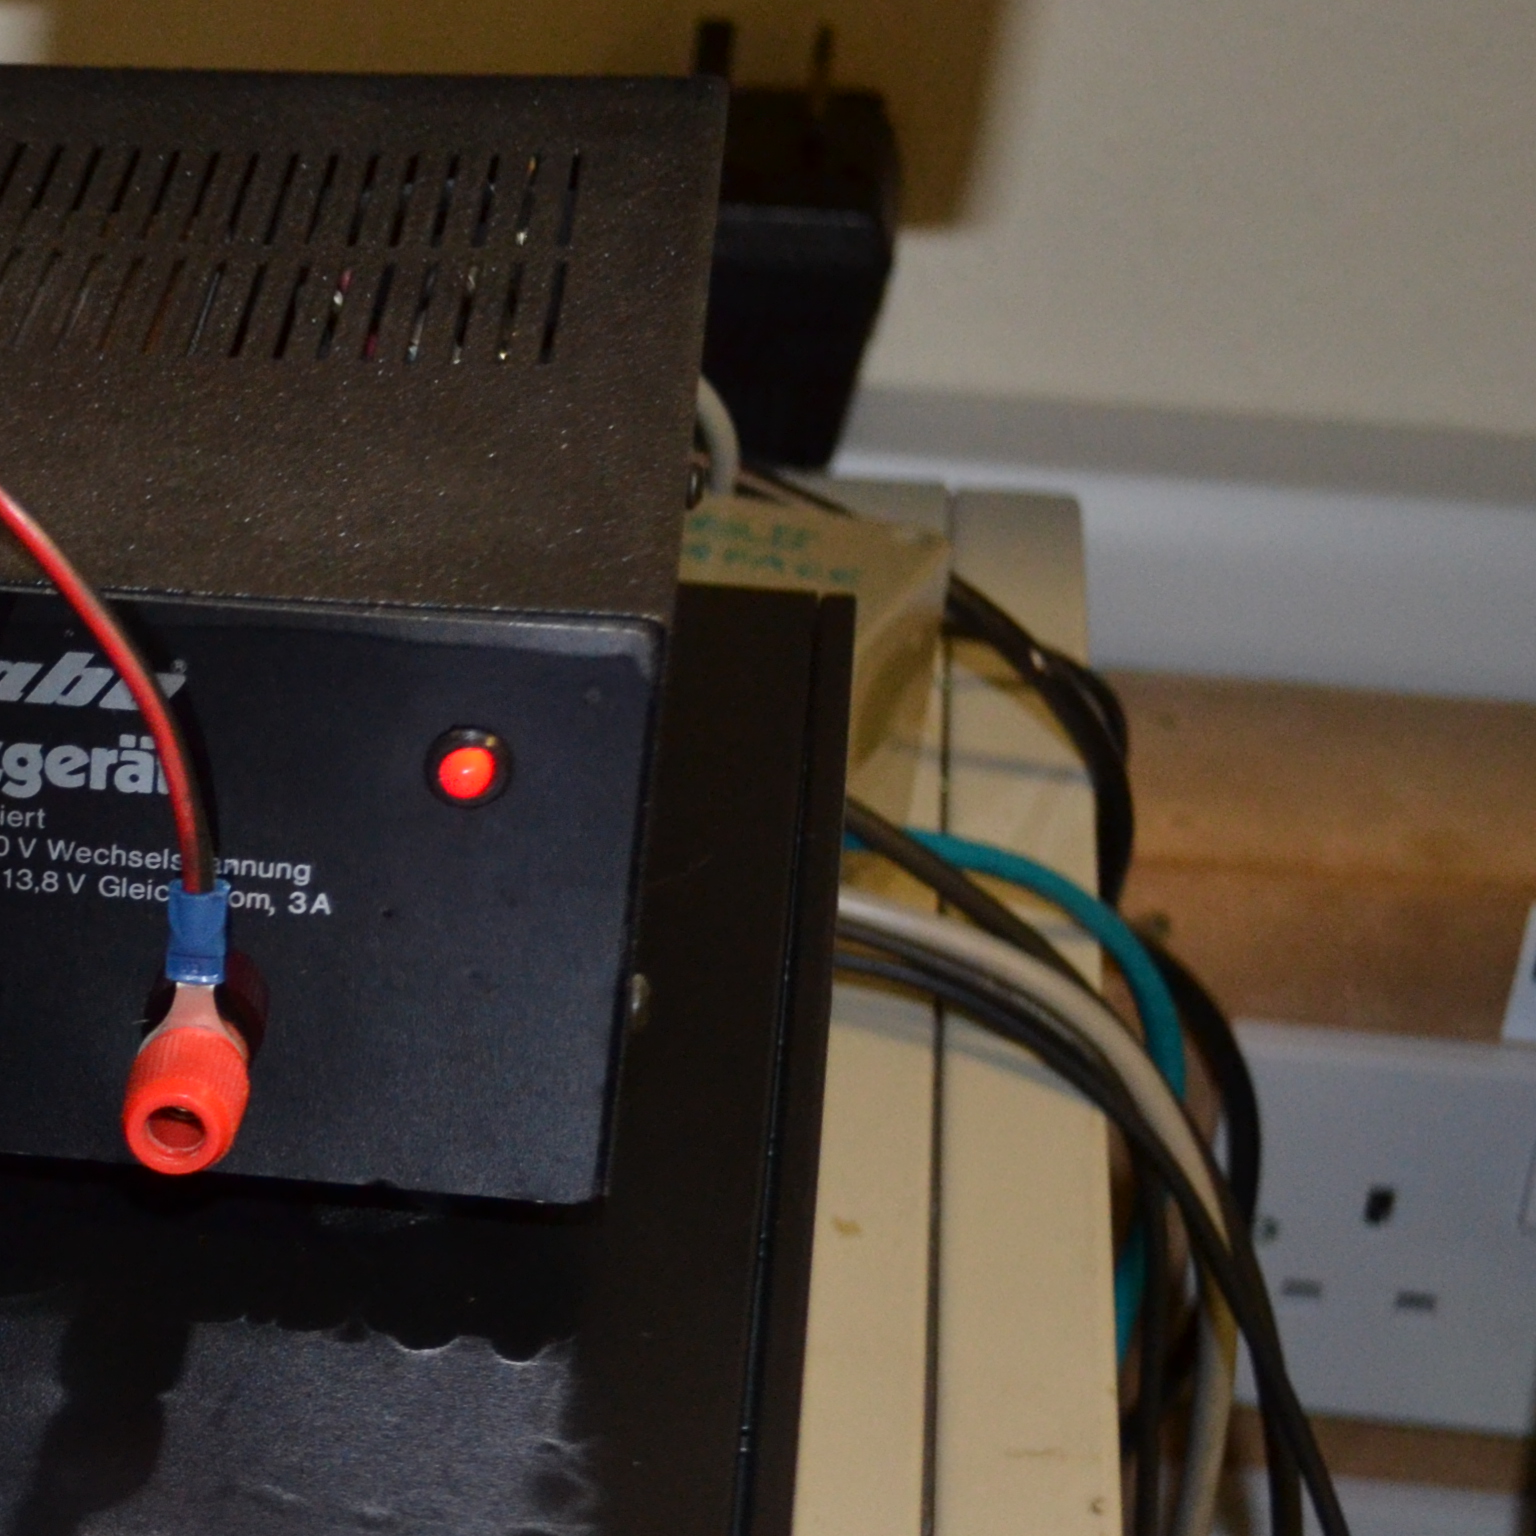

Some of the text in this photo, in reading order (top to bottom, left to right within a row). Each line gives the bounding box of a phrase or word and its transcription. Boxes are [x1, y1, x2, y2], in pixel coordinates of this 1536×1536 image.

[18, 836, 37, 859] V
[47, 838, 312, 886] Wechselsannung
[3, 868, 59, 894] 13,8
[98, 875, 275, 917] Gleicom,
